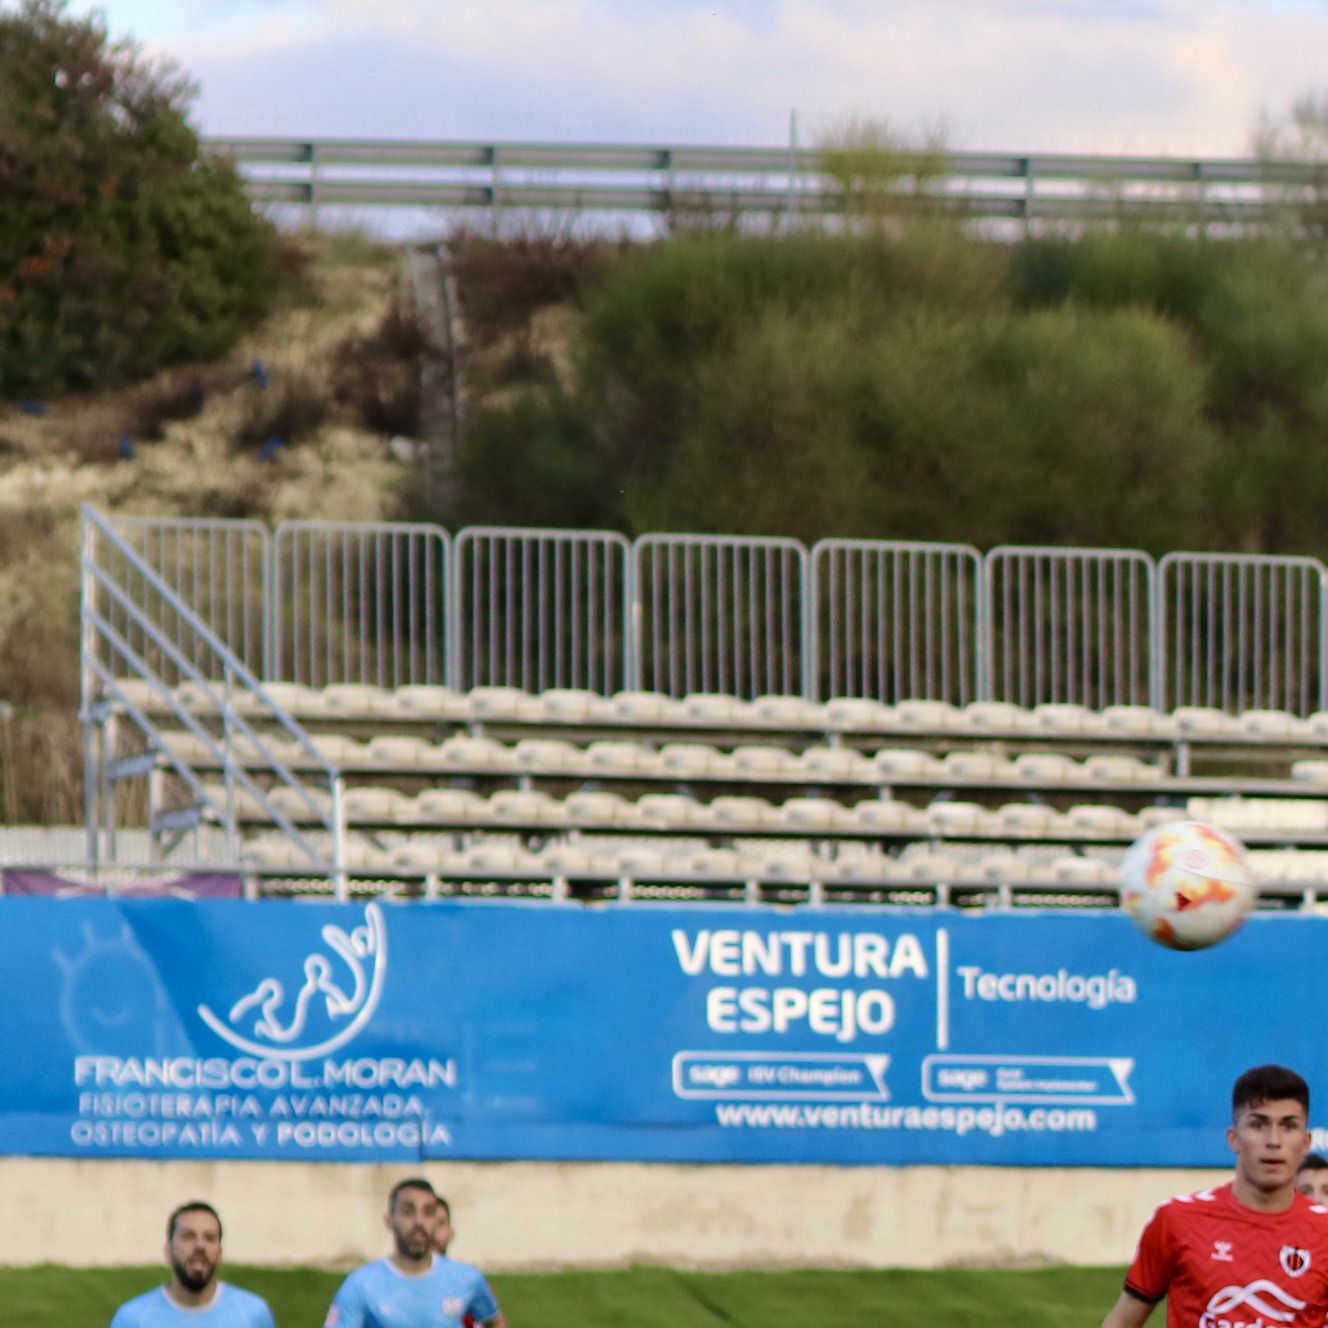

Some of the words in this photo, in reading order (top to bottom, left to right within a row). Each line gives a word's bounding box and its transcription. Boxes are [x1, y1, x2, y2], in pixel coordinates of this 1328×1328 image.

[671, 929, 928, 977] VENTURA
[956, 966, 1136, 1008] Tecnología
[706, 987, 895, 1042] ESPEJO
[79, 1091, 262, 1118] FISIOTERAPIA
[716, 1101, 1097, 1137] www.venturaespejo.com
[251, 1122, 268, 1146] Y
[277, 1120, 454, 1147] PODOLOGÍA
